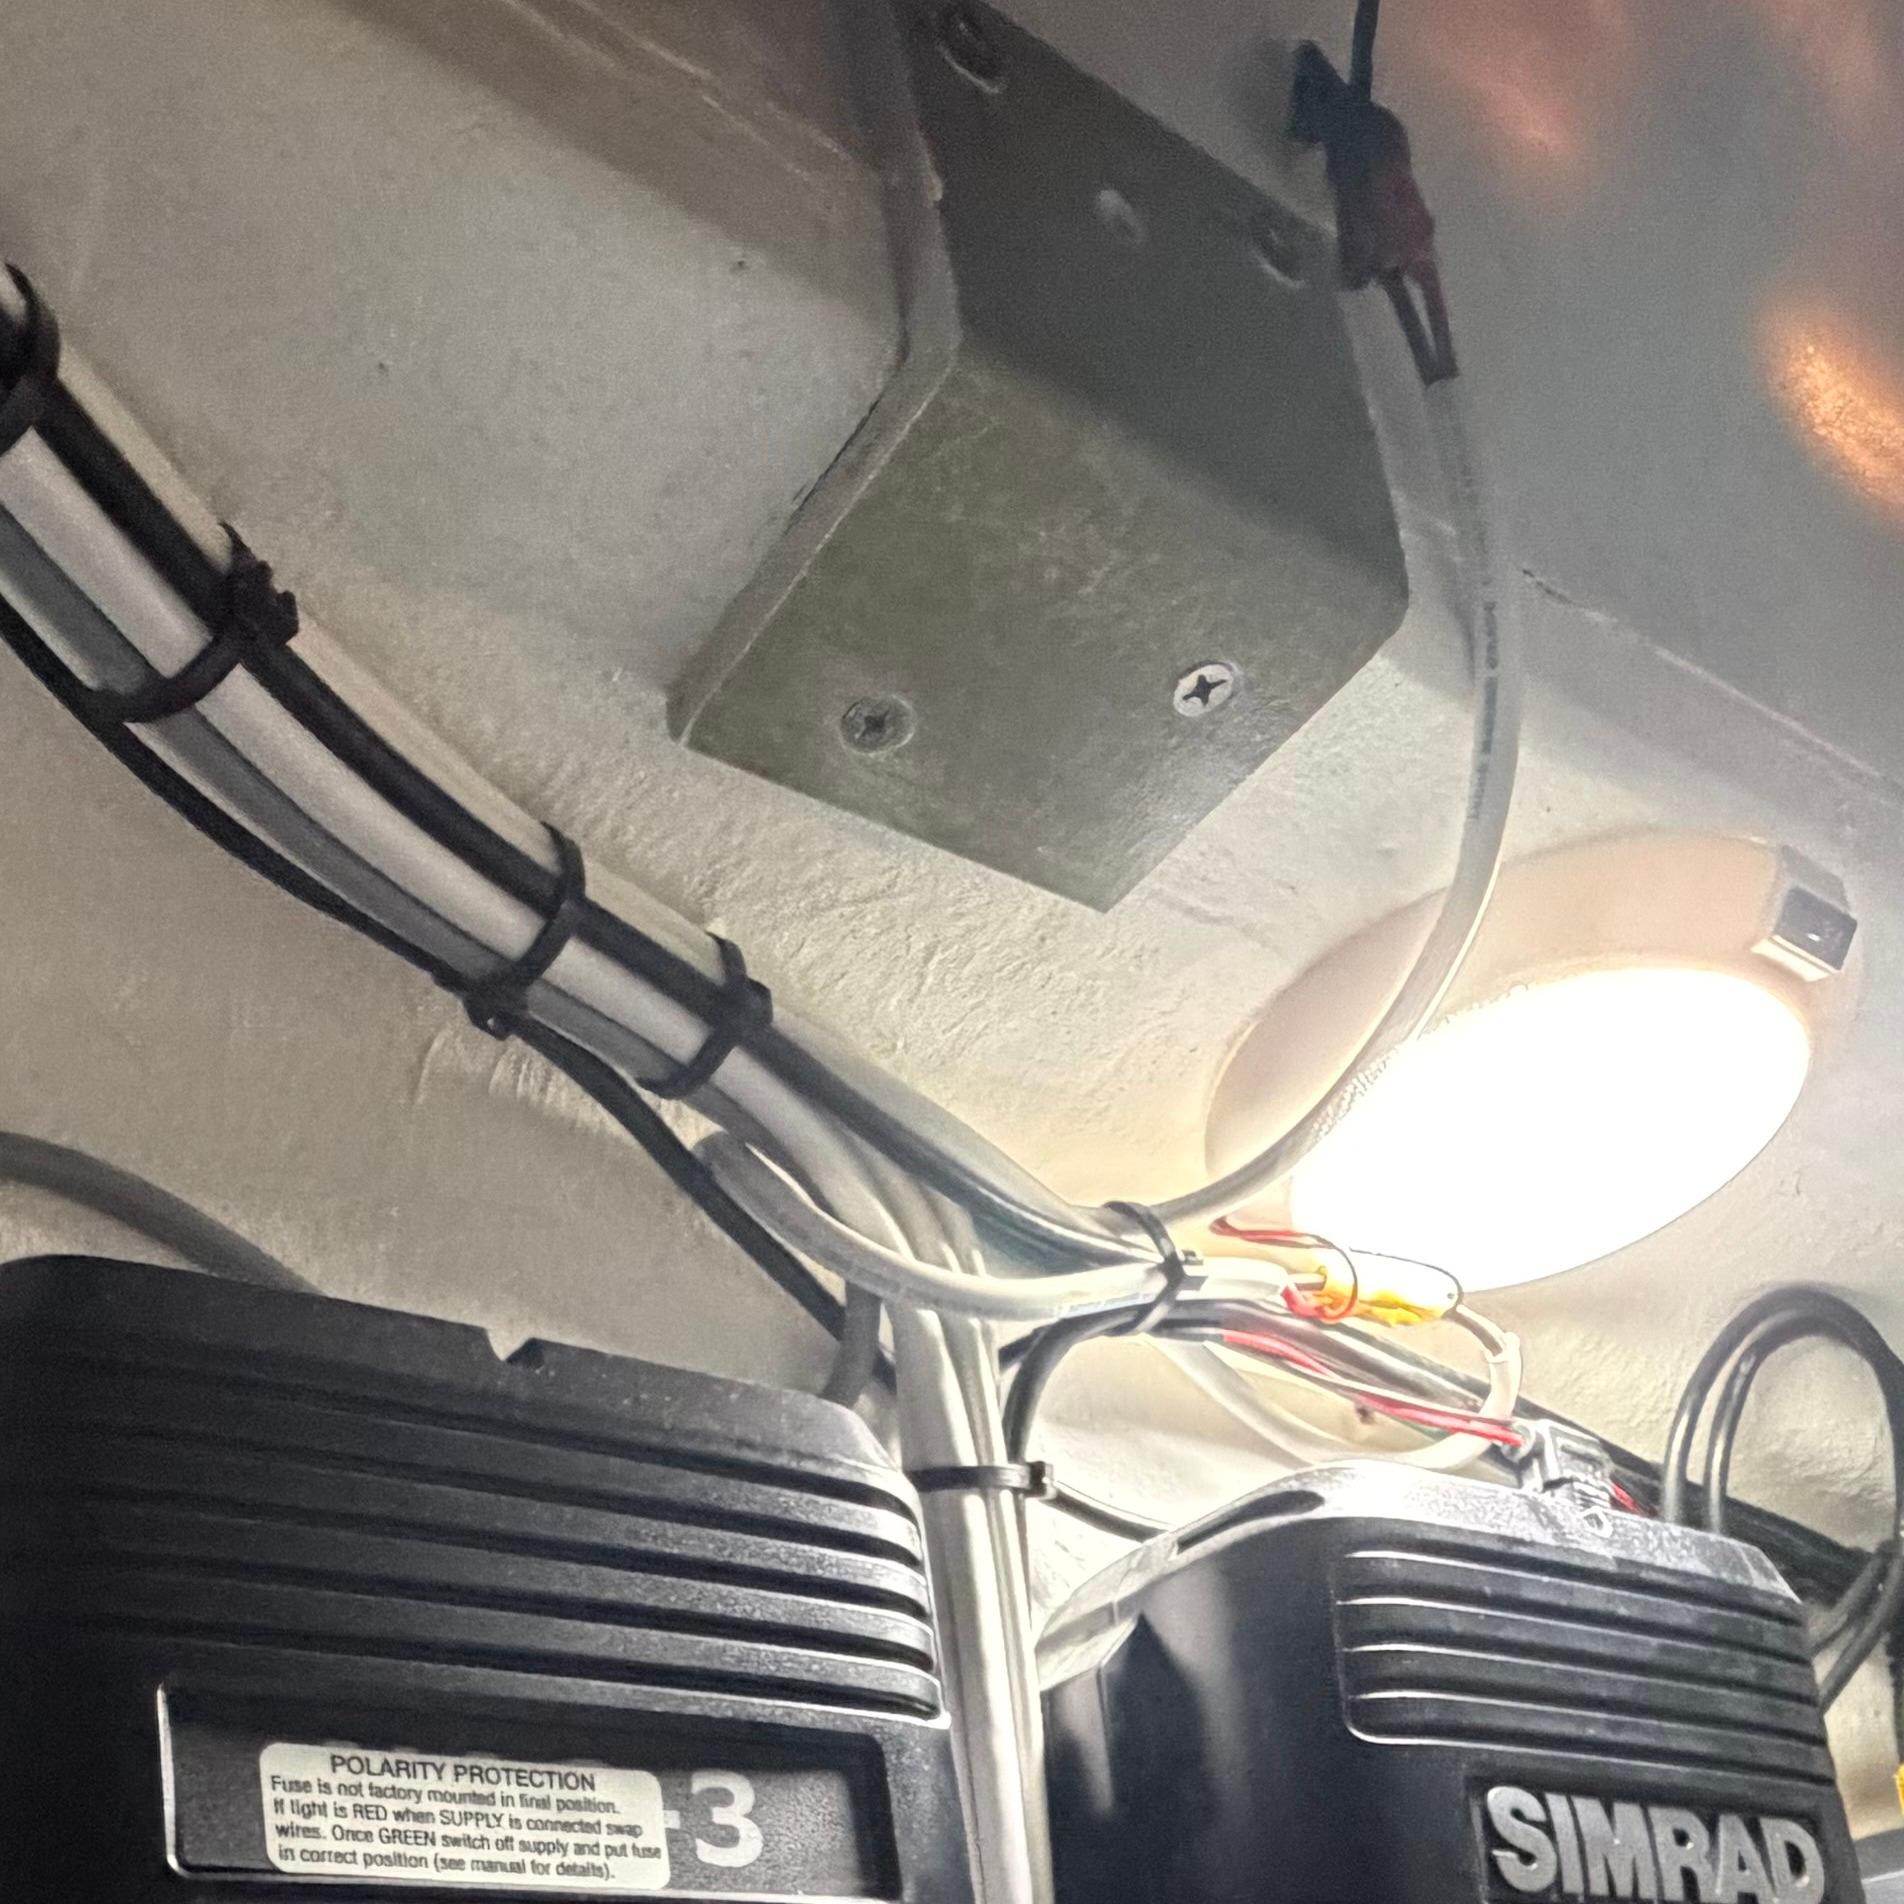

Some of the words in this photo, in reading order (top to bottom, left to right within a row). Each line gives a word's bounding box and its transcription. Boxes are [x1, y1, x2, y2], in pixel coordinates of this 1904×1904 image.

[330, 1755, 446, 1781] POLARITY
[453, 1764, 596, 1792] PROTECTION
[271, 1775, 312, 1794] Fuse
[318, 1779, 332, 1796] is
[338, 1781, 365, 1798] not
[368, 1781, 423, 1804] factory
[427, 1788, 496, 1807] mounted
[501, 1791, 515, 1808] in
[519, 1793, 552, 1811] final
[556, 1798, 622, 1815] position.
[274, 1798, 285, 1816] If
[290, 1799, 328, 1820] light
[333, 1802, 347, 1819] is
[353, 1803, 388, 1822] RED
[392, 1806, 436, 1824] when
[439, 1809, 505, 1830] SUPPLY
[509, 1814, 522, 1831] is
[526, 1816, 602, 1835] connected
[606, 1823, 644, 1839] swap
[275, 1823, 327, 1840] wires.
[331, 1824, 375, 1843] Once
[379, 1827, 437, 1847] GREEN
[441, 1832, 490, 1850] switch
[496, 1835, 514, 1852] off
[518, 1838, 570, 1858] supply
[573, 1842, 601, 1856] and
[604, 1844, 628, 1860] put
[632, 1842, 662, 1859] fuse
[278, 1844, 296, 1861] in
[300, 1848, 358, 1865] correct
[363, 1851, 429, 1870] position
[433, 1852, 466, 1873] (see
[470, 1857, 526, 1875] manual
[530, 1859, 551, 1876] for
[556, 1861, 616, 1880] details).
